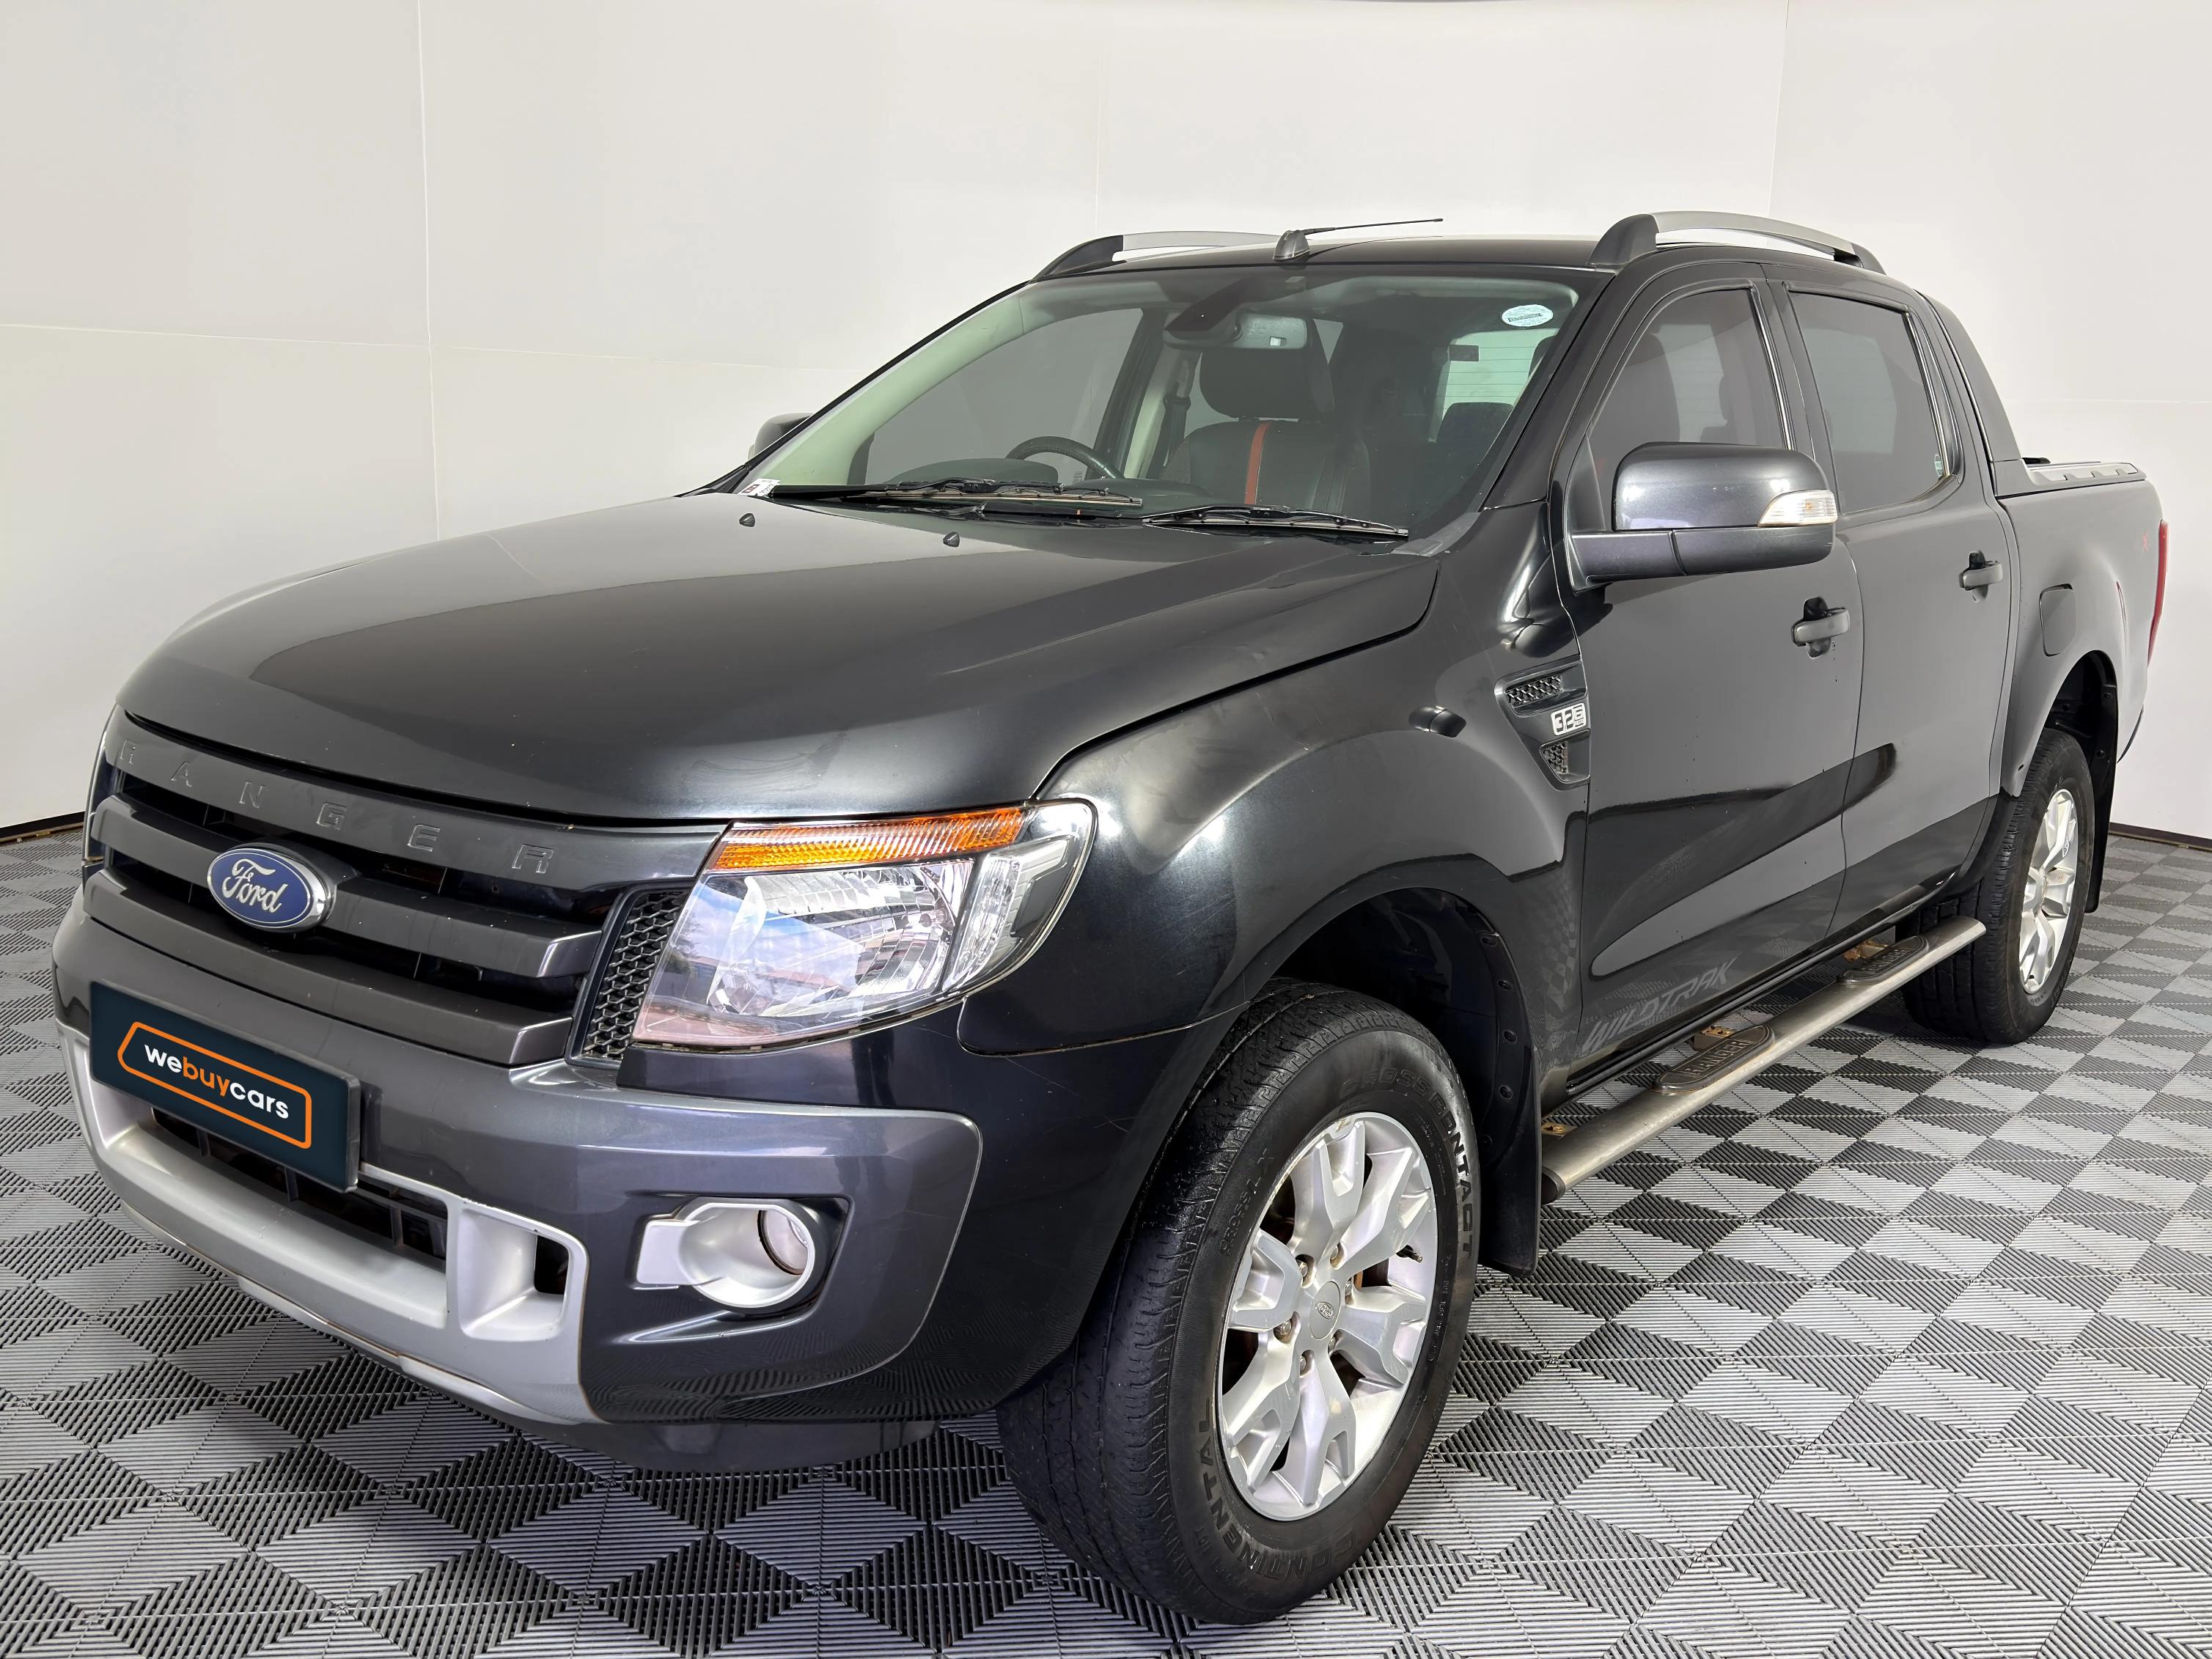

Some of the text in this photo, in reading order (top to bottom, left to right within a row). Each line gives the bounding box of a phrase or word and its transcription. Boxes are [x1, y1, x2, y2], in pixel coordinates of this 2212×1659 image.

[118, 738, 555, 874] RANGER
[222, 858, 287, 914] Ford
[1581, 957, 1737, 1054] WILDTRAK
[144, 1043, 289, 1119] webuycars
[1198, 1396, 1356, 1581] CONTINENTAL
